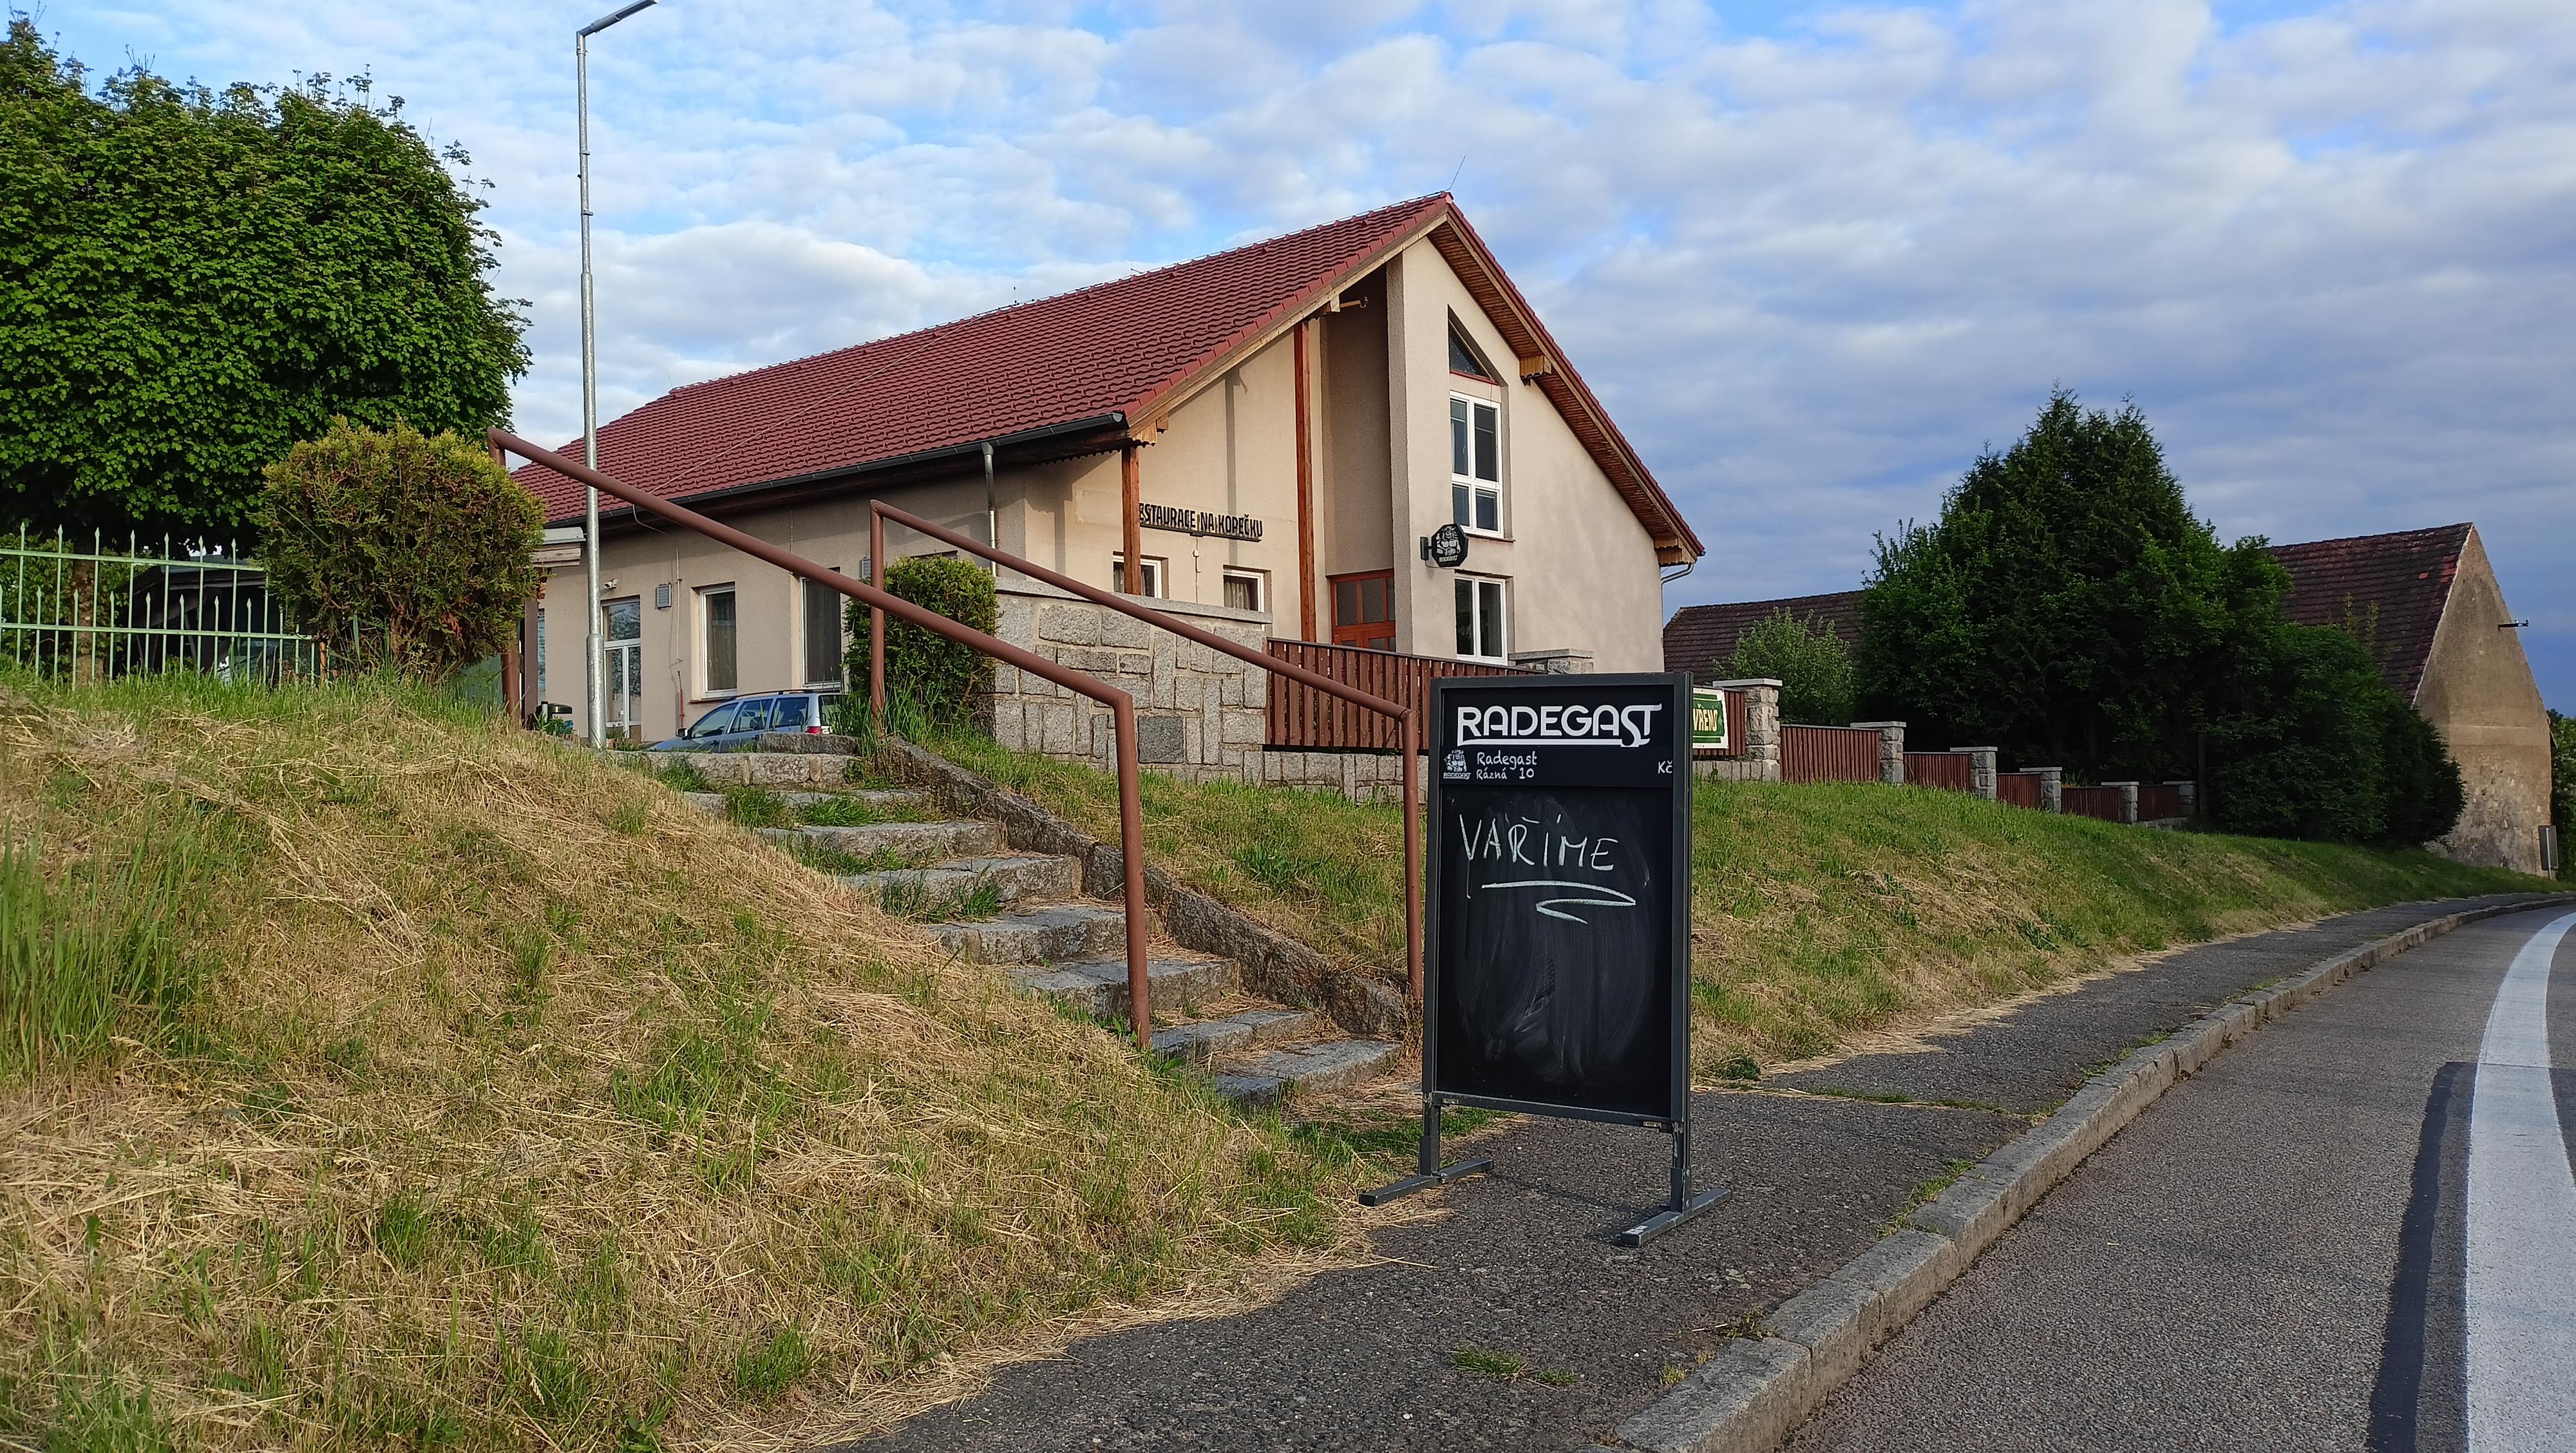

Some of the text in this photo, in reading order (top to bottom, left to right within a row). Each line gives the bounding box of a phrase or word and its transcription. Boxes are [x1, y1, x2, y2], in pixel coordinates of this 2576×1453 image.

[1139, 503, 1263, 537] ESTAURACE NA KOPEČKU
[1457, 703, 1662, 747] RADEGAST
[1692, 703, 1718, 732] VŘENO
[1477, 750, 1537, 770] Radegast
[1658, 760, 1673, 774] Kč
[1476, 766, 1535, 780] Rázná 10
